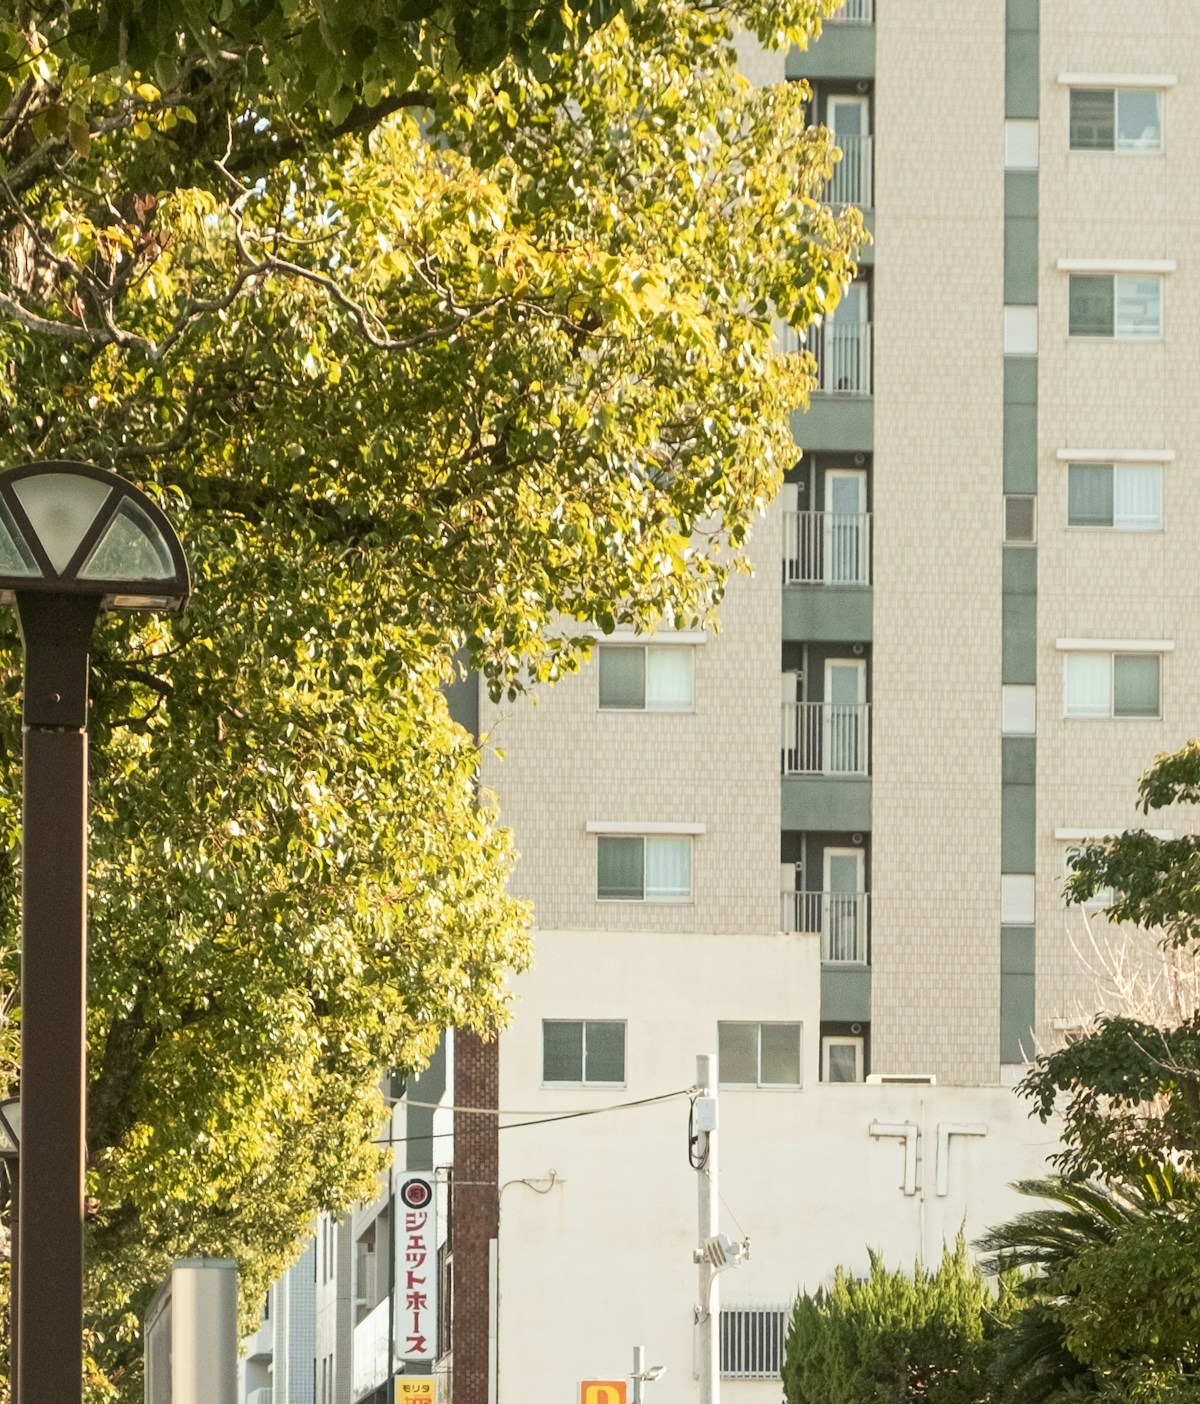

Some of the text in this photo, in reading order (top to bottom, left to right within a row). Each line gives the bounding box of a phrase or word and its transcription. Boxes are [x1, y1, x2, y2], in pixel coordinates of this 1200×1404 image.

[408, 1187, 425, 1199] JET
[405, 1212, 429, 1354] ジェットホース
[402, 1384, 430, 1393] モリタ
